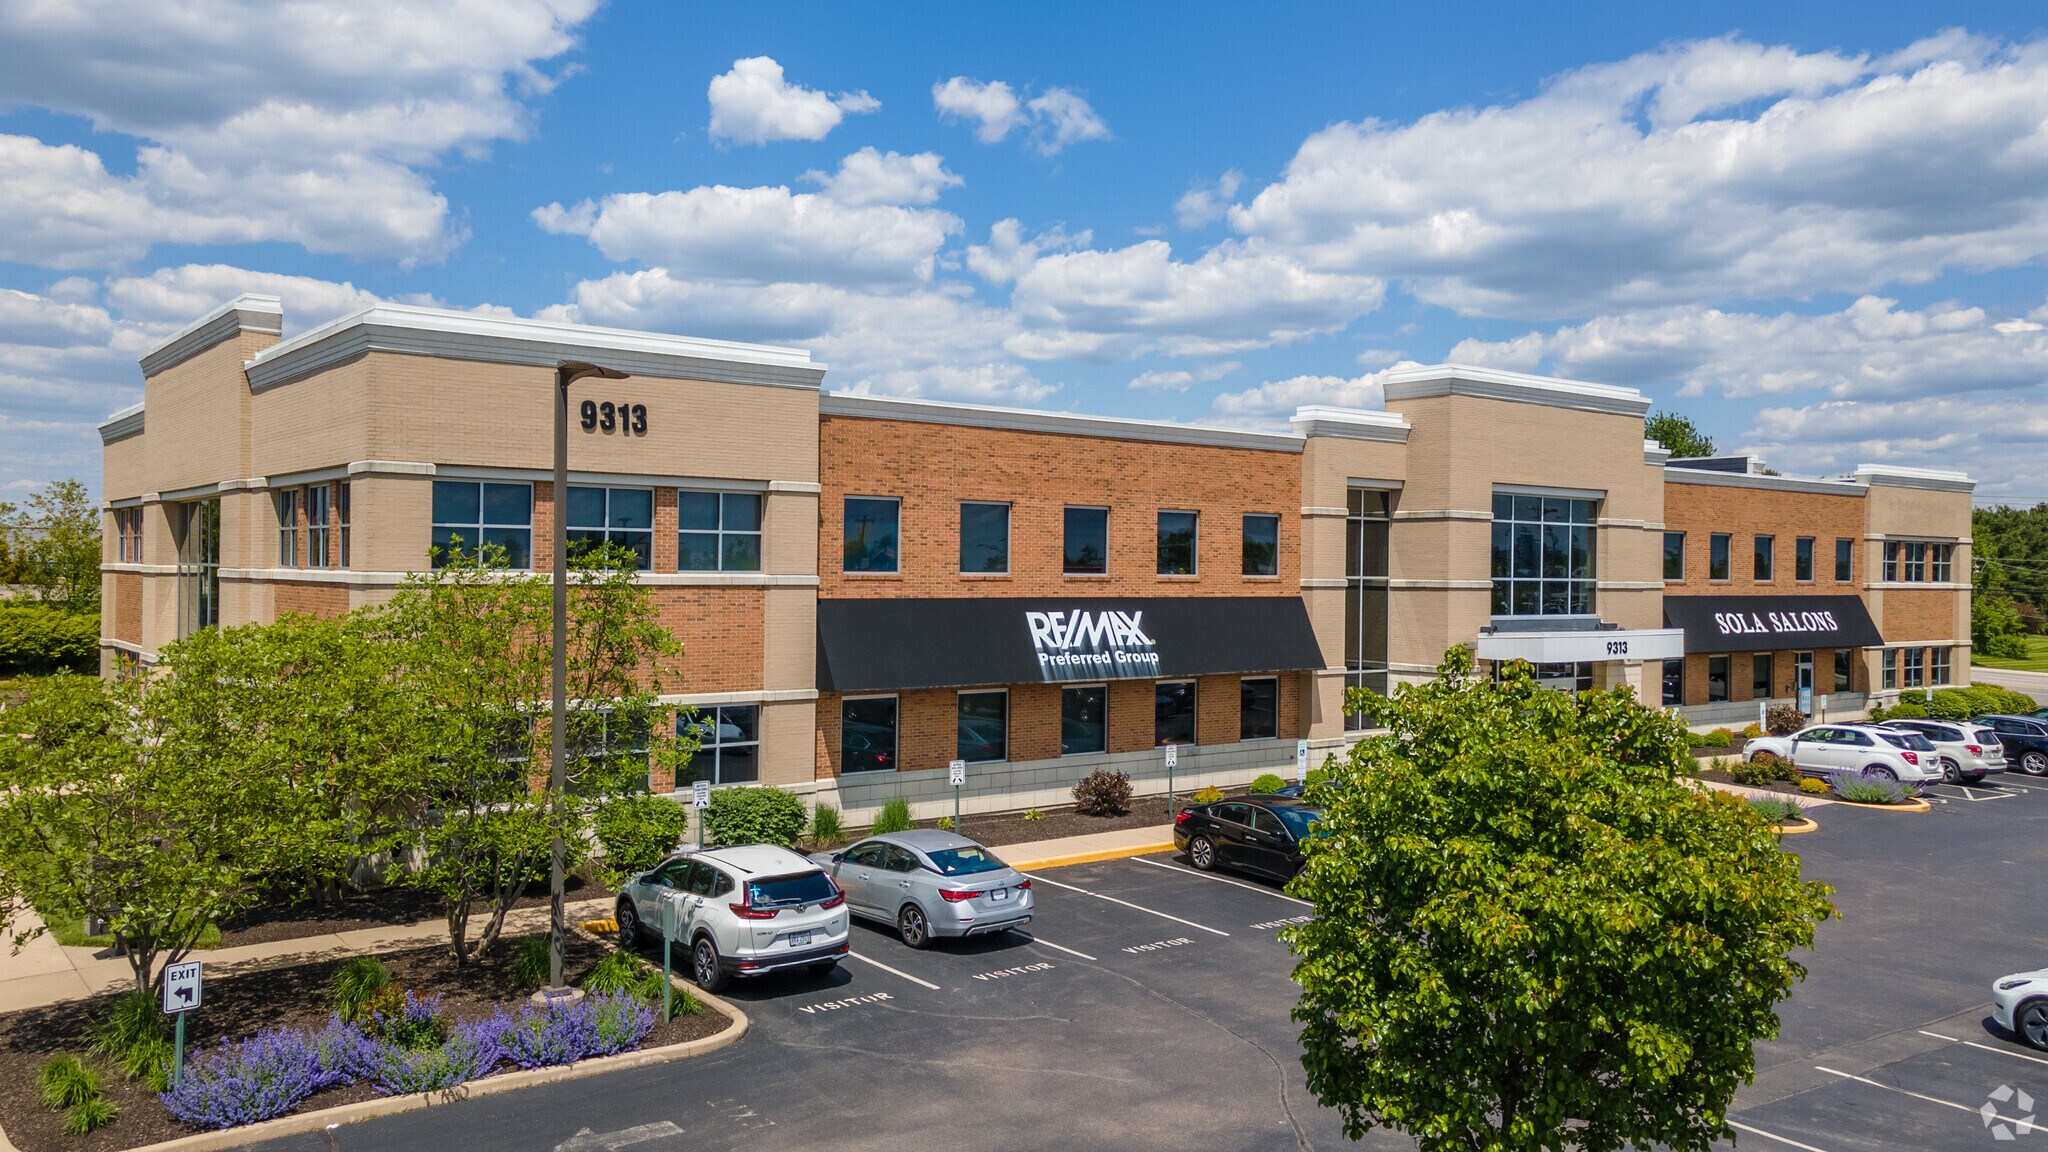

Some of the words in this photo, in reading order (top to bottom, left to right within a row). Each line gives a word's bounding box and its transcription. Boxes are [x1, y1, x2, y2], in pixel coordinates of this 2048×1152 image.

[581, 400, 647, 433] 9313
[1026, 609, 1151, 649] RE/MAX
[1715, 612, 1769, 634] SOLA
[1769, 611, 1838, 632] SALONS
[1607, 641, 1628, 655] 9313
[1038, 651, 1111, 666] Preferred
[1115, 650, 1159, 664] Group
[1249, 915, 1316, 930] VISITOR
[1121, 937, 1195, 953] VISITOR
[171, 968, 197, 981] EXIT
[972, 963, 1056, 981] VISITOR
[798, 992, 894, 1013] VISITOR
